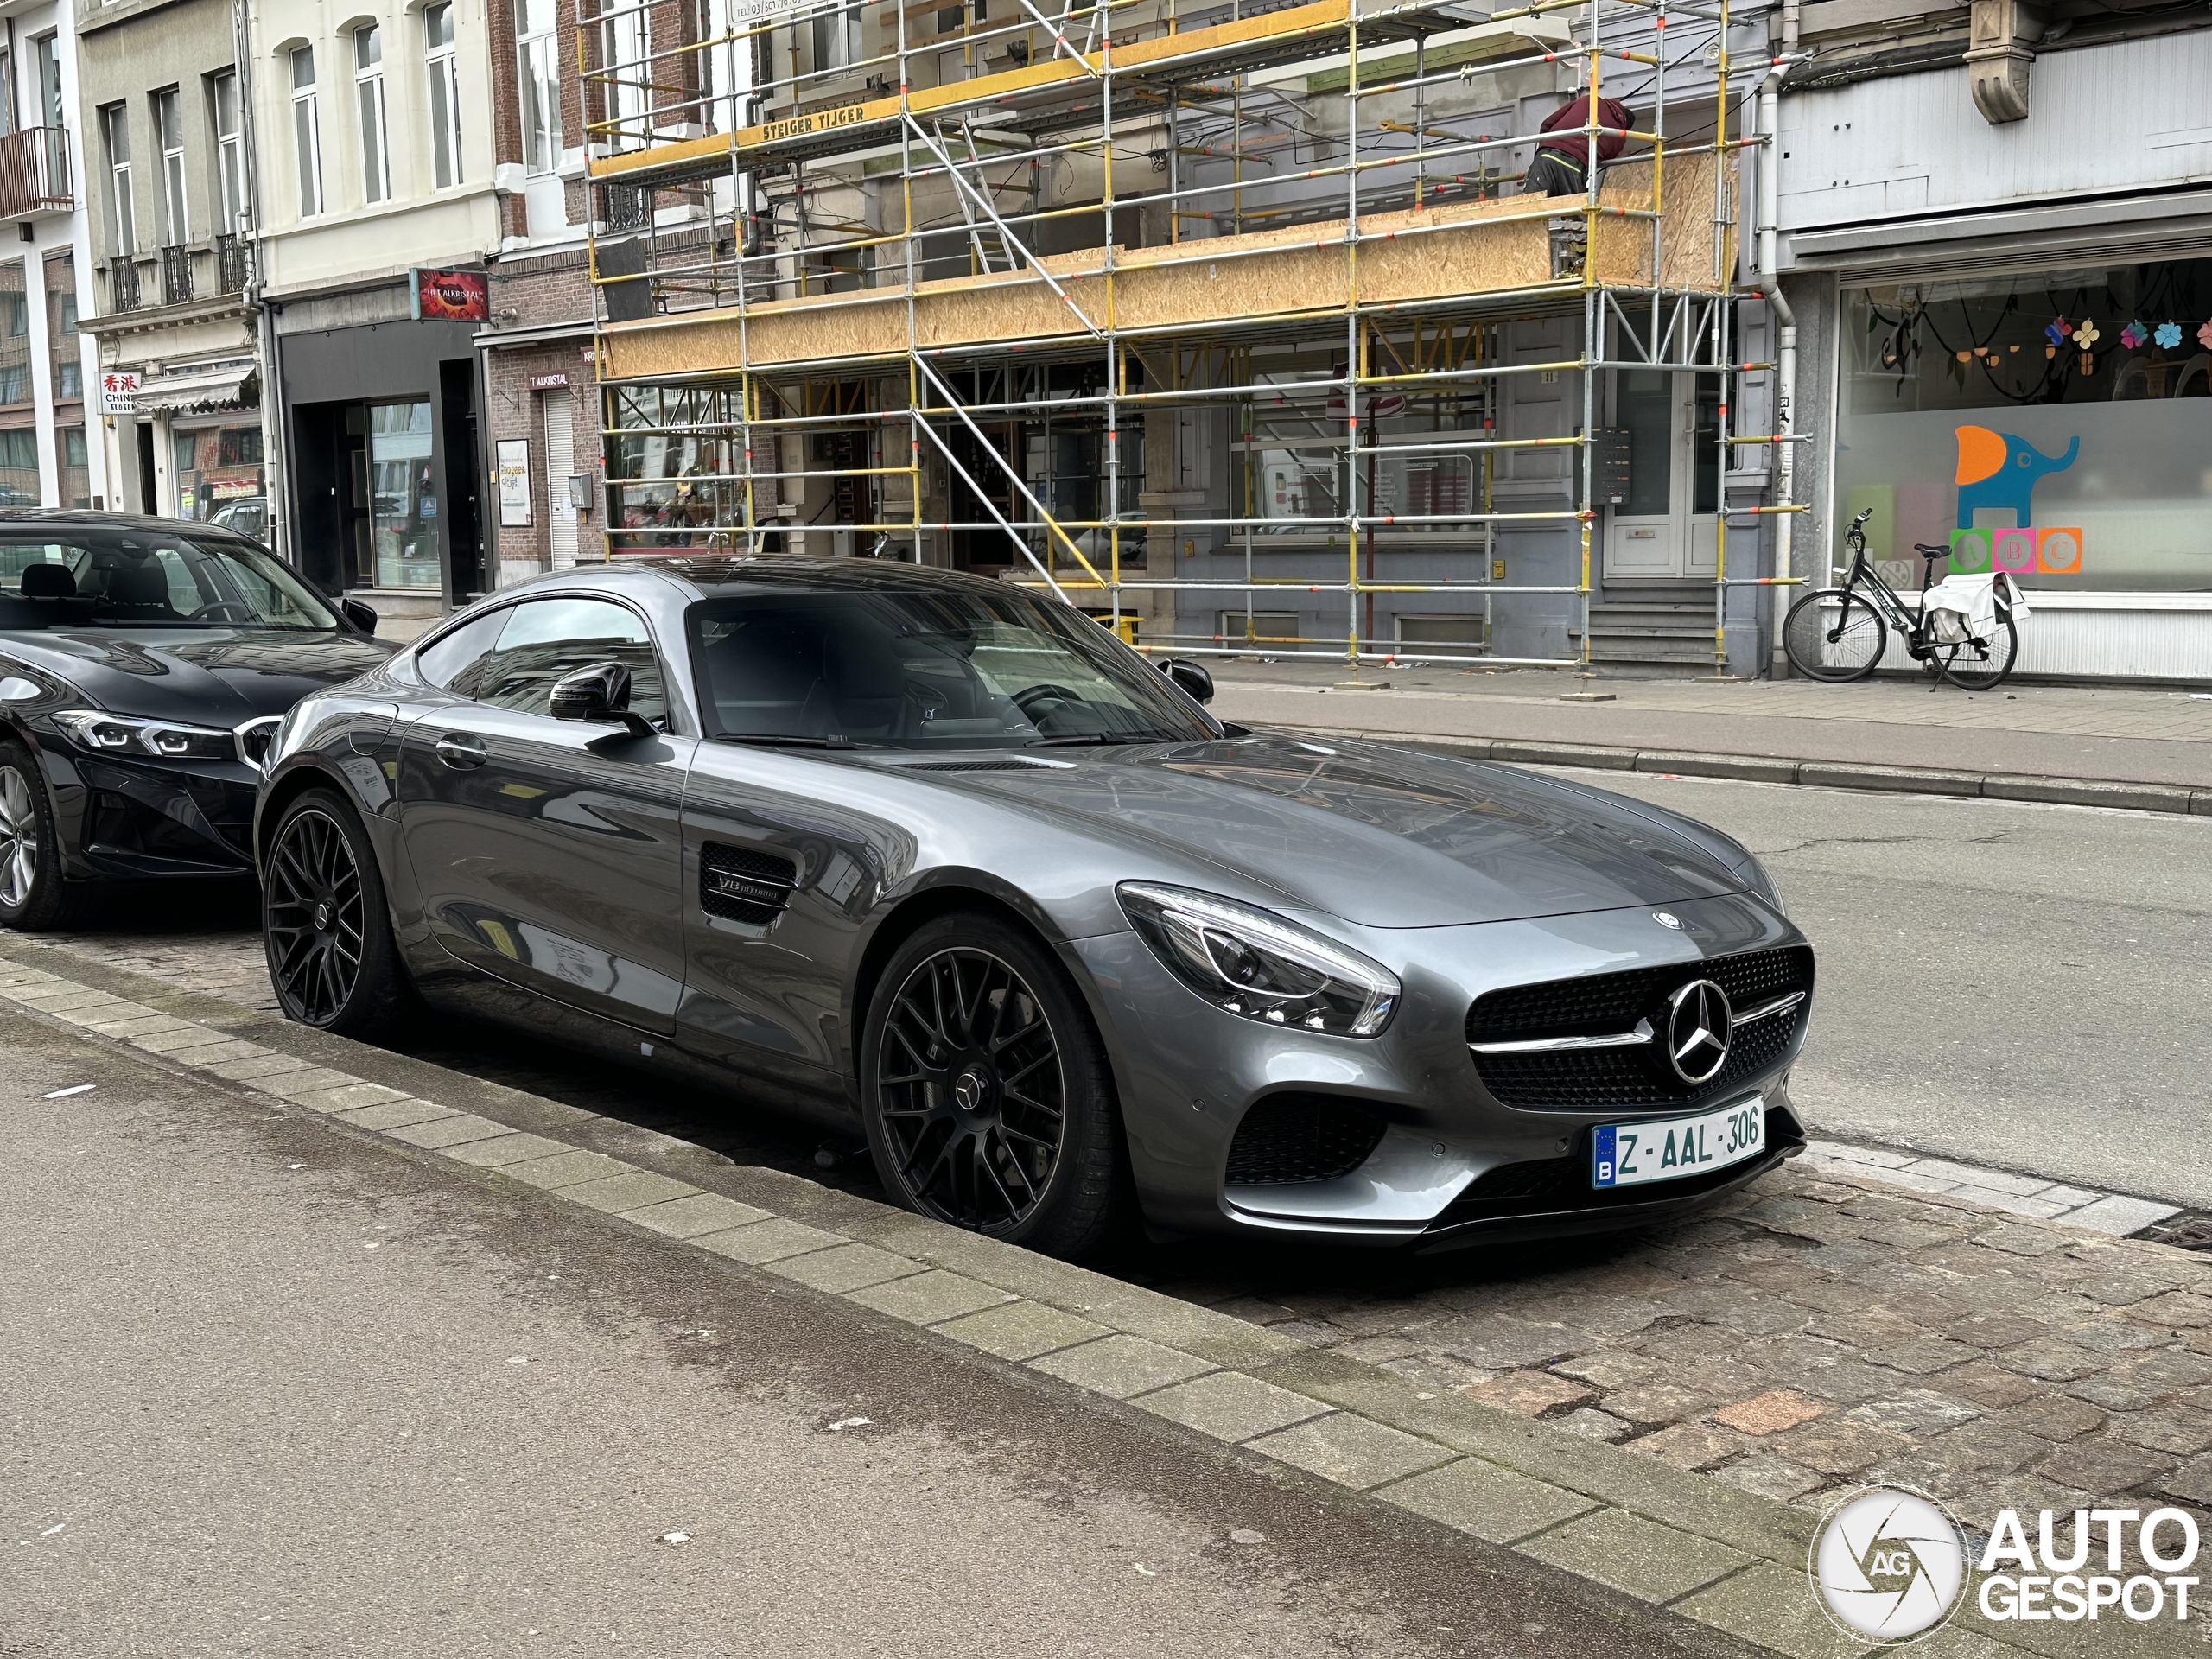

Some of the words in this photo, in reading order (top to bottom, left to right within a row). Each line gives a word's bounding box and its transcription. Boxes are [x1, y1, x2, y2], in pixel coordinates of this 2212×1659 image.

[763, 118, 812, 140] STEIGER
[818, 107, 863, 129] TIJGER
[104, 374, 138, 392] 香港
[537, 374, 568, 386] ALKRISTAL
[1546, 372, 1553, 383] 11
[105, 394, 133, 403] CHIN
[2007, 542, 2021, 560] B
[2051, 541, 2068, 561] C
[1618, 1105, 1758, 1175] Z-AAL-306
[1599, 1161, 1612, 1180] B
